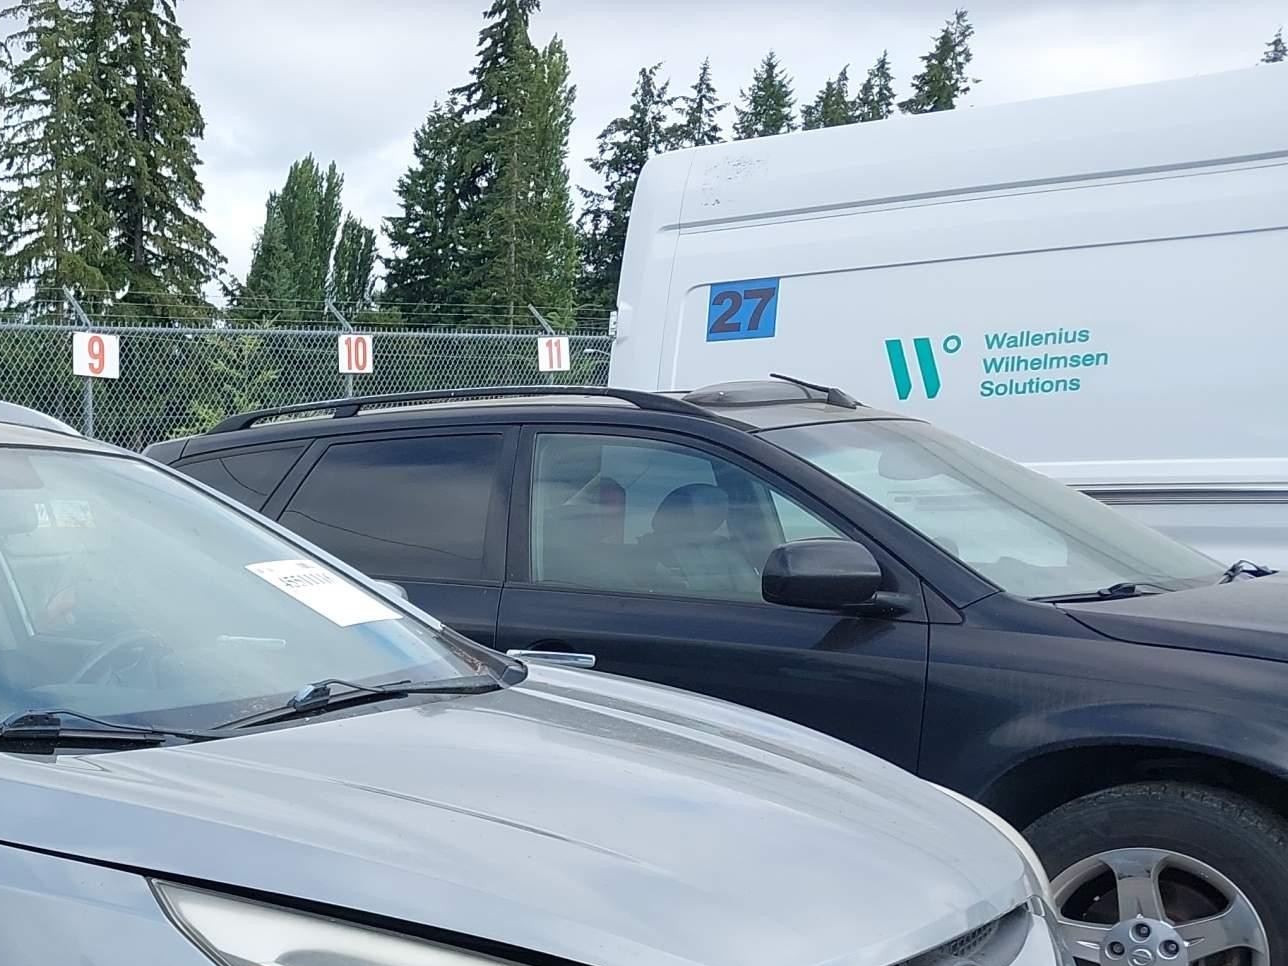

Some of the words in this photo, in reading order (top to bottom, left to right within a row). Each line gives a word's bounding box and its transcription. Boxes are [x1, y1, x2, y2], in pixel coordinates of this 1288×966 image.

[709, 289, 777, 334] 27
[86, 334, 108, 375] 9
[345, 335, 370, 371] 10
[546, 338, 563, 371] 11
[983, 327, 1091, 350] Wallenius
[982, 350, 1110, 375] Wilhelmsen
[979, 376, 1082, 398] Solutions
